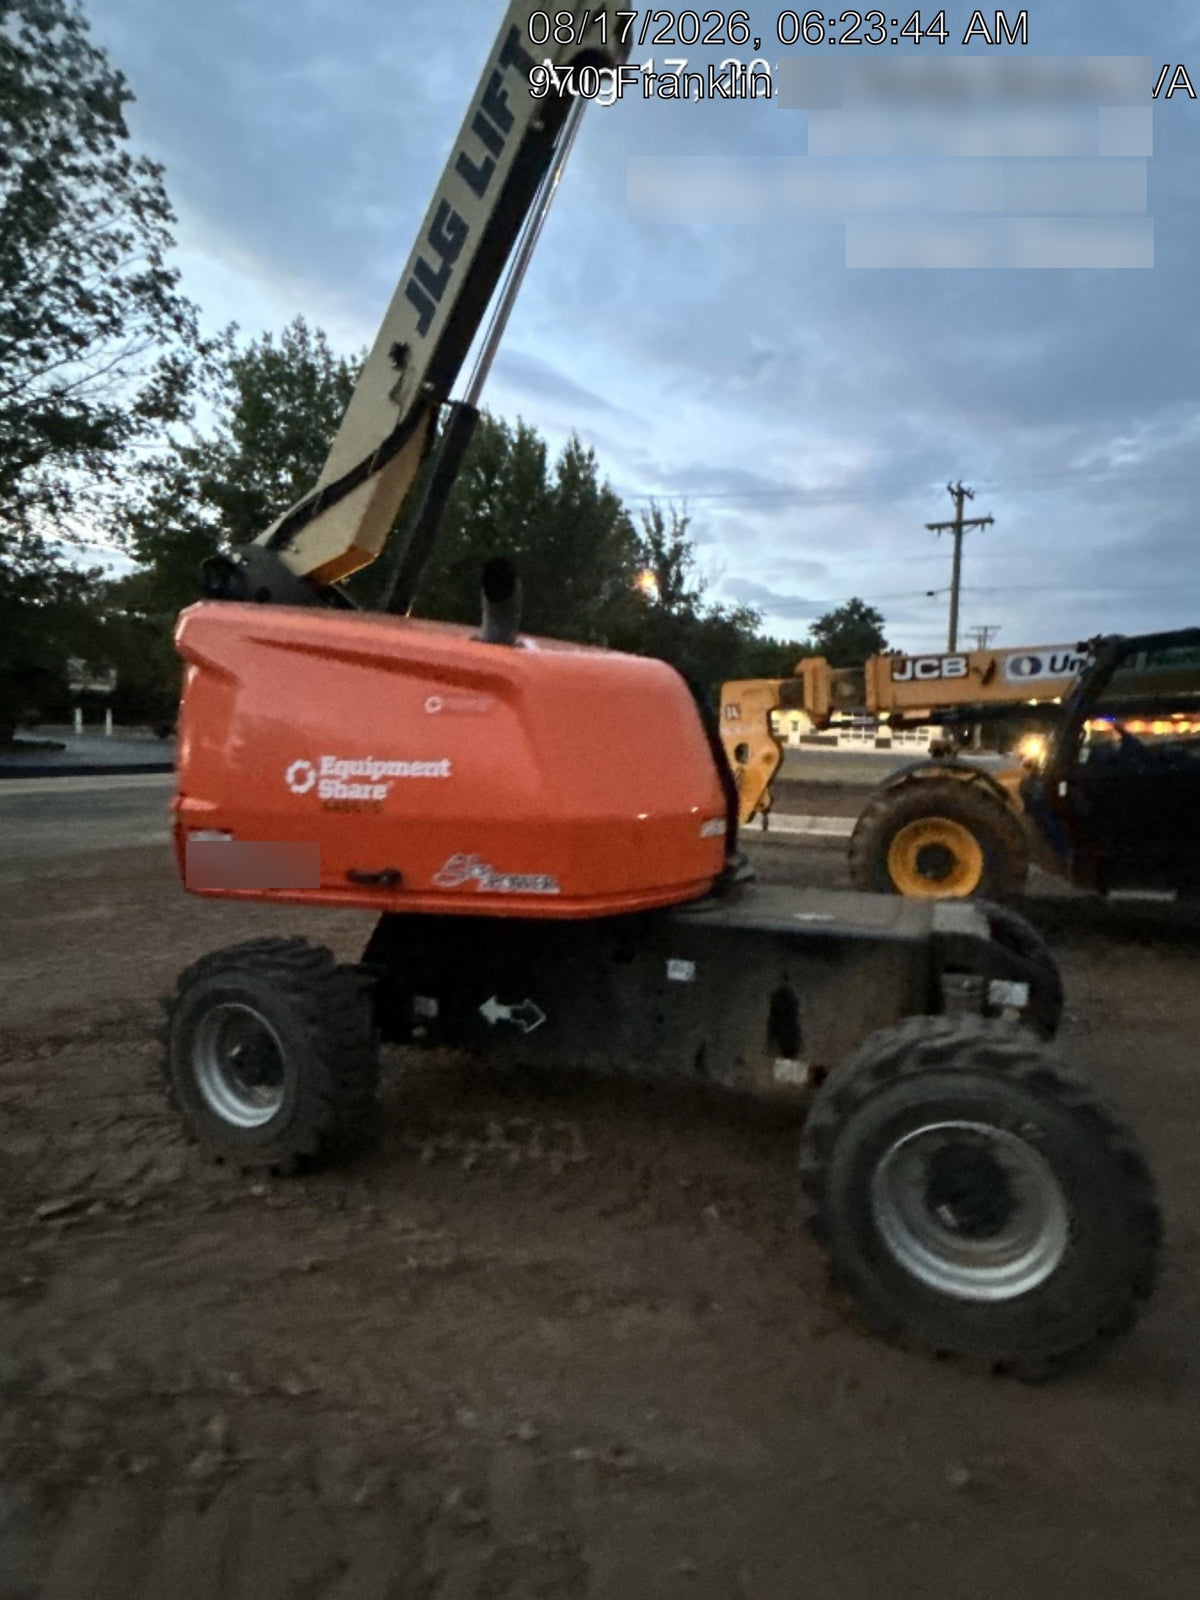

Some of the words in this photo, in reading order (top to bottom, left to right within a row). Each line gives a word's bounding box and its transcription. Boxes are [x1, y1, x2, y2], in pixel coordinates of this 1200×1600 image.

[404, 198, 470, 339] JLG
[454, 23, 541, 200] LIFT
[892, 656, 968, 681] JCB
[319, 755, 452, 781] Equipment
[317, 778, 389, 801] Share
